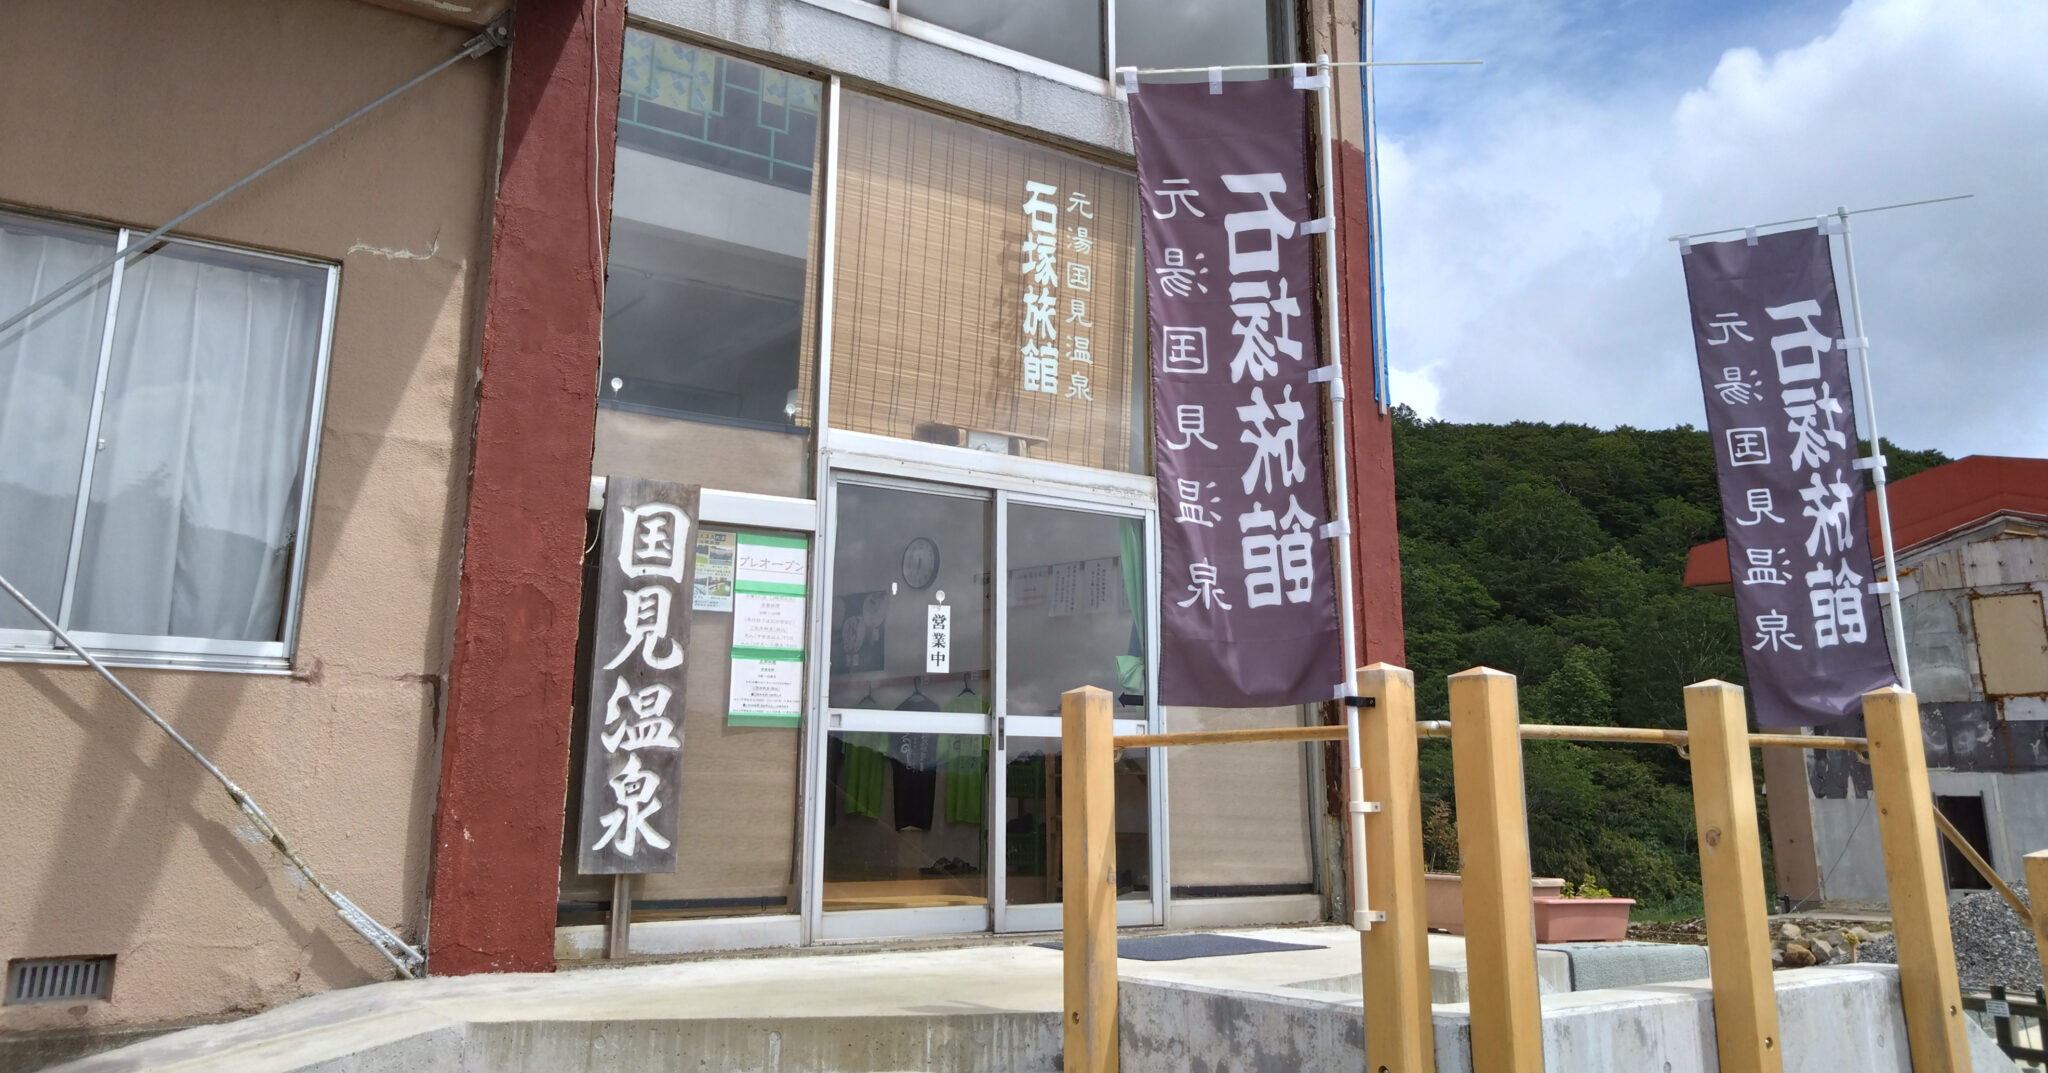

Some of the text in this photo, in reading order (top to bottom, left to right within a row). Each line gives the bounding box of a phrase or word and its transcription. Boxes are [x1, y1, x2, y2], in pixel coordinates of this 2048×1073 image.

[1021, 180, 1059, 395] 石塚旅館
[1065, 191, 1094, 401] 元湯国見温泉
[739, 556, 805, 572] プレオープン
[931, 614, 947, 667] 営業中
[592, 501, 691, 857] 国見温泉
